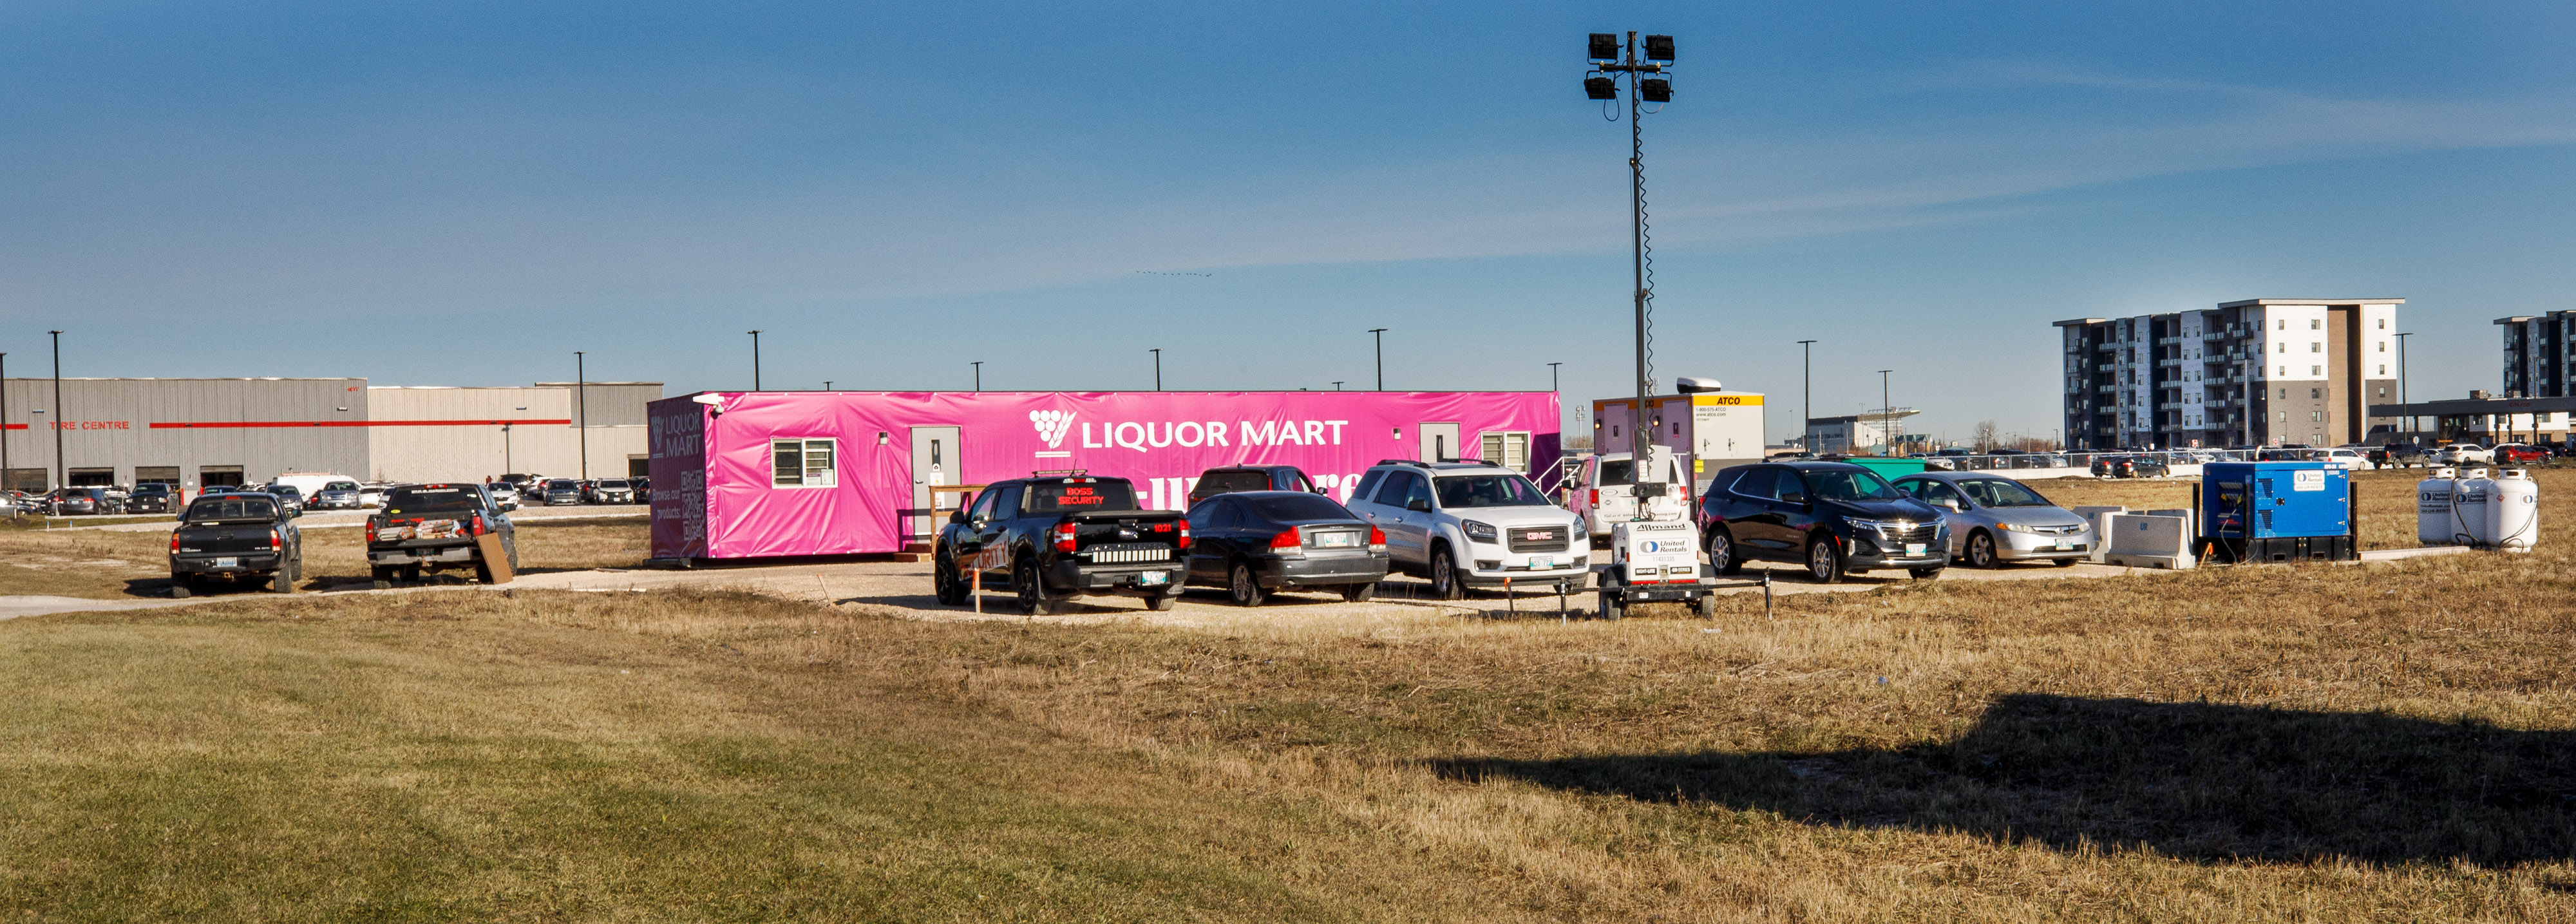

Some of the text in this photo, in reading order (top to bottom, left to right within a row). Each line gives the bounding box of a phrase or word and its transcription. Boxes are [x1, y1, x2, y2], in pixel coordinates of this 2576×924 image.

[1717, 397, 1740, 405] ATCO
[50, 420, 129, 430] TRE CENTRE
[666, 412, 700, 435] LIQUOR
[1083, 420, 1349, 453] LIQUOR MART
[667, 434, 701, 458] MART
[652, 488, 680, 502] Browse our
[1154, 524, 1171, 533] 1021
[1527, 532, 1553, 540] GMC
